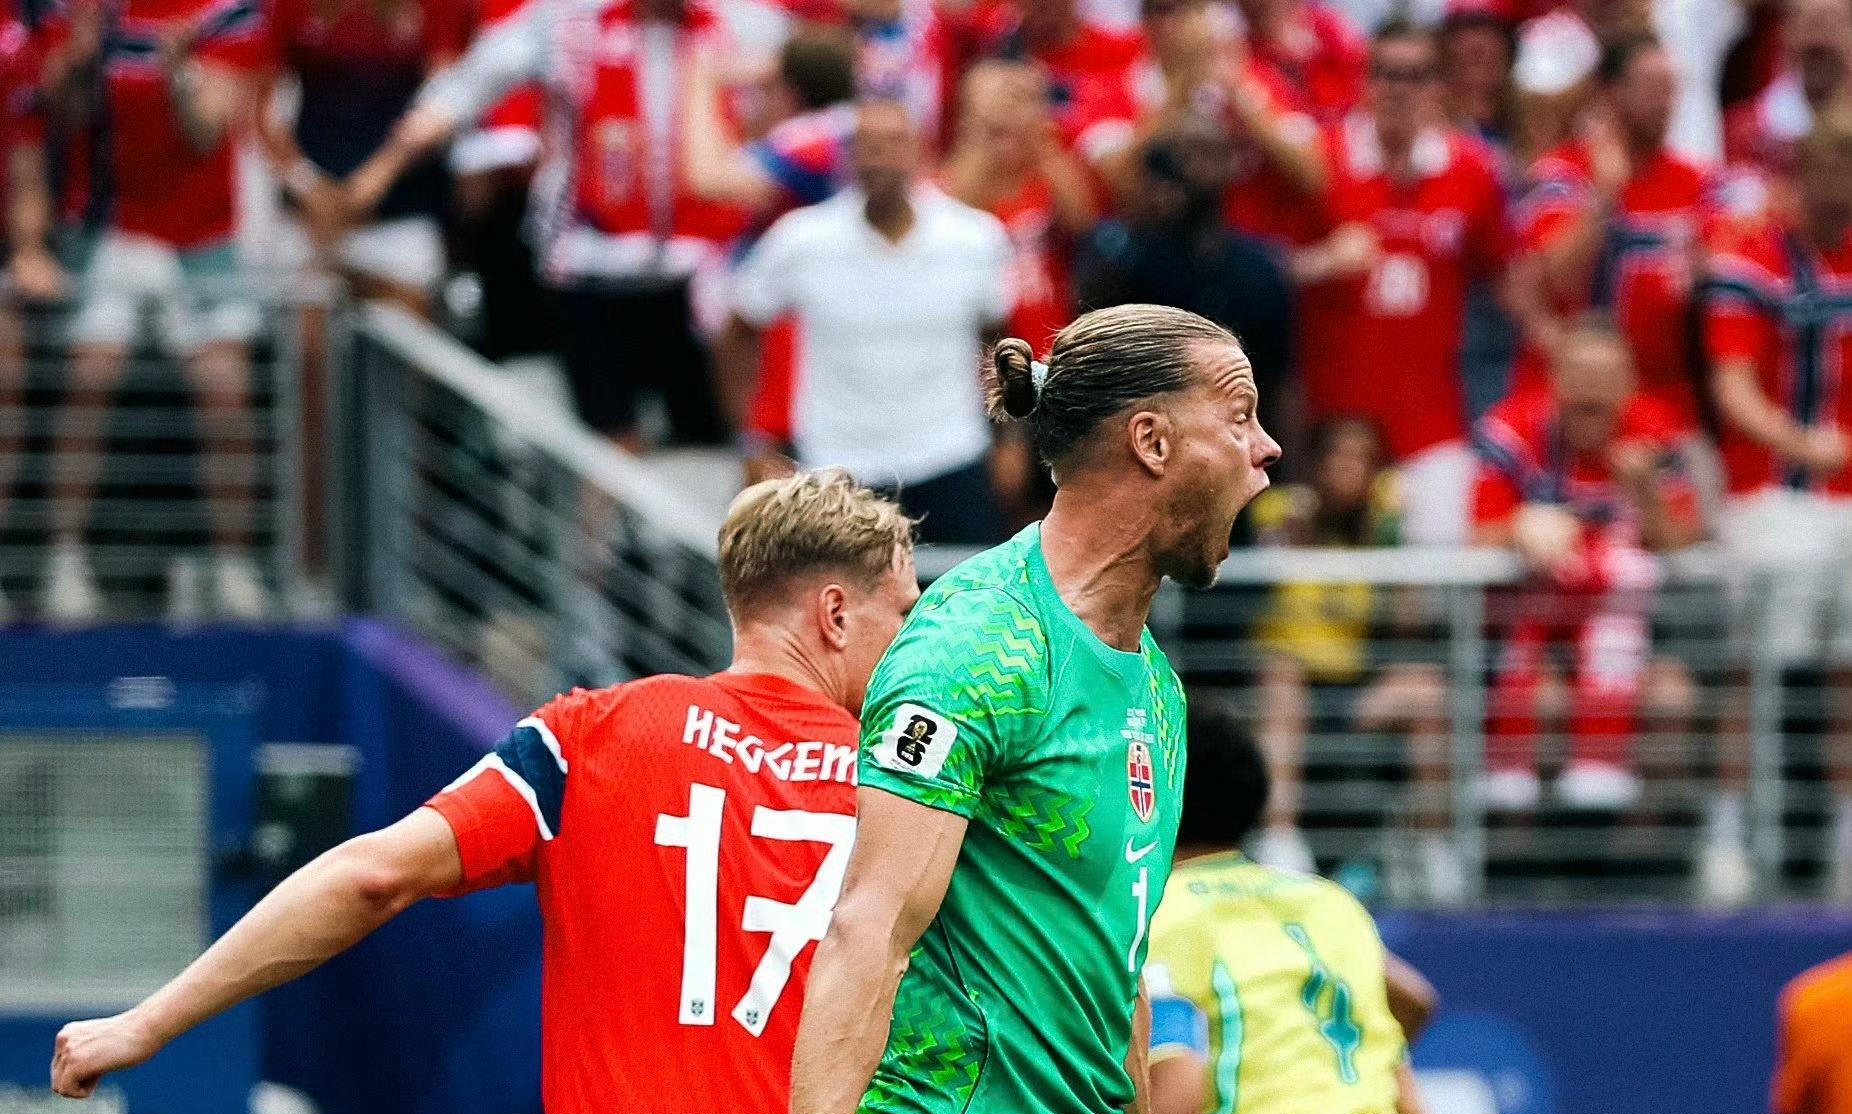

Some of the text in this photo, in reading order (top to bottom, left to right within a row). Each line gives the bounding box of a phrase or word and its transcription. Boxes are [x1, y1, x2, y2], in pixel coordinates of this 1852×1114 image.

[682, 704, 858, 787] HEGGEM
[653, 782, 858, 1038] 17
[1127, 866, 1149, 973] 1
